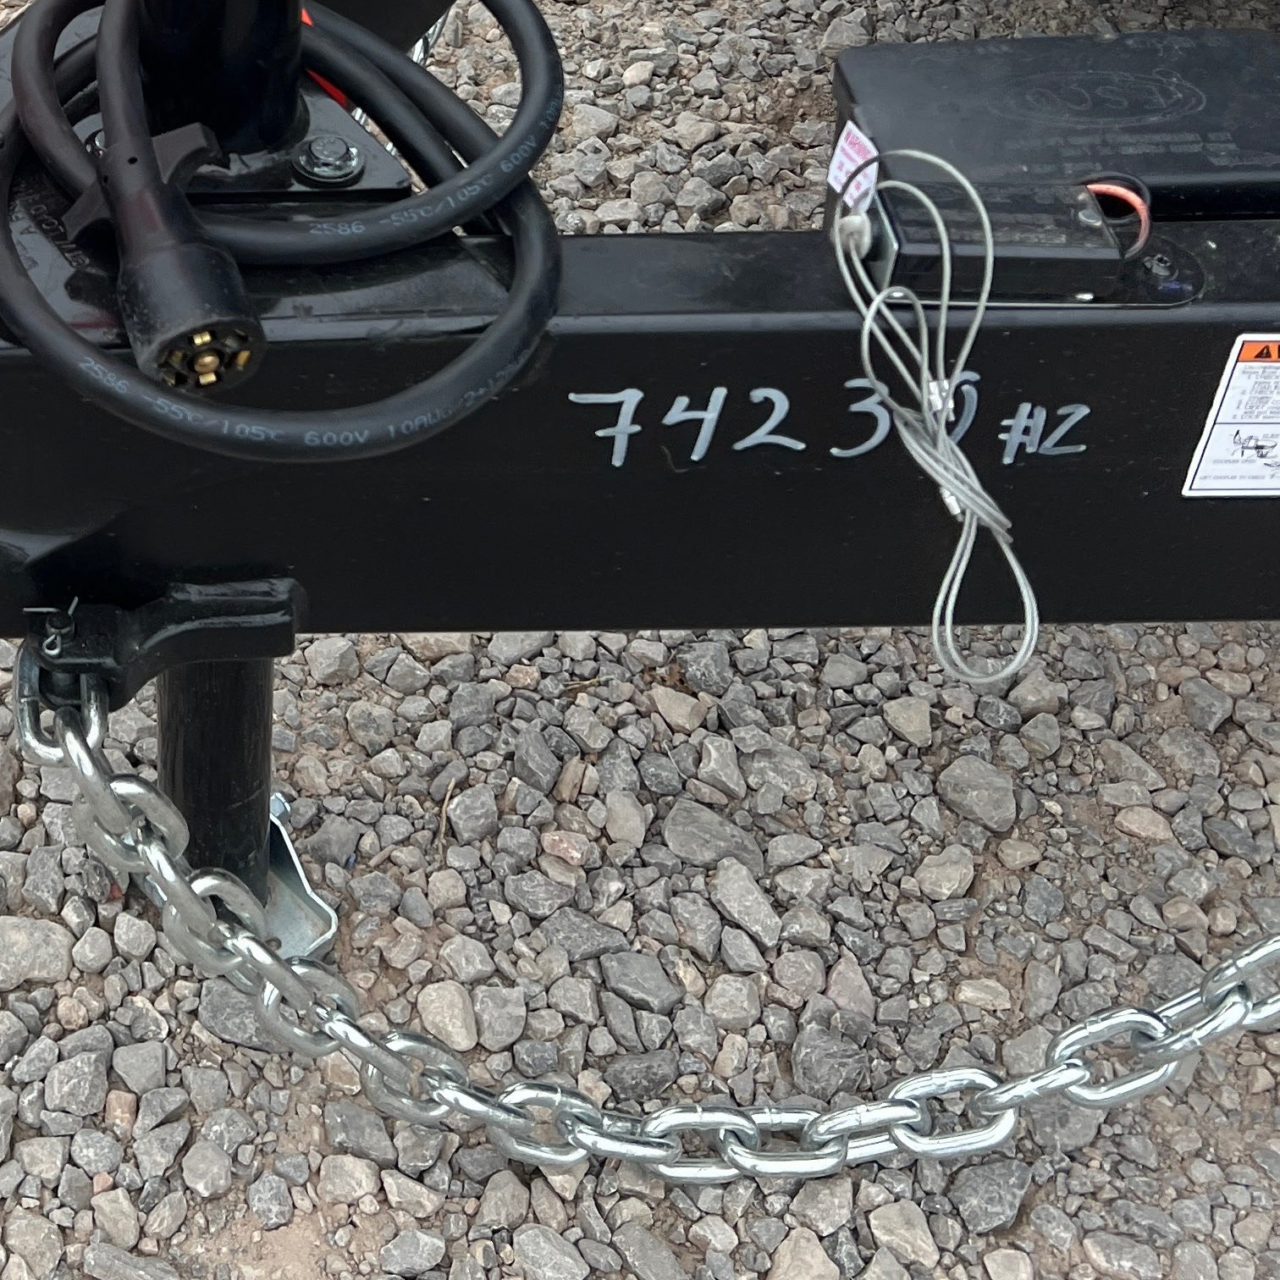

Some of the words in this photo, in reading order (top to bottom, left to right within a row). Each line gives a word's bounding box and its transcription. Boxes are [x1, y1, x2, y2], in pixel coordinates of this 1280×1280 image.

[308, 221, 366, 236] 2586
[499, 134, 539, 174] 600V
[78, 356, 131, 395] 2586
[303, 428, 370, 447] 600V
[997, 401, 1092, 465] #2
